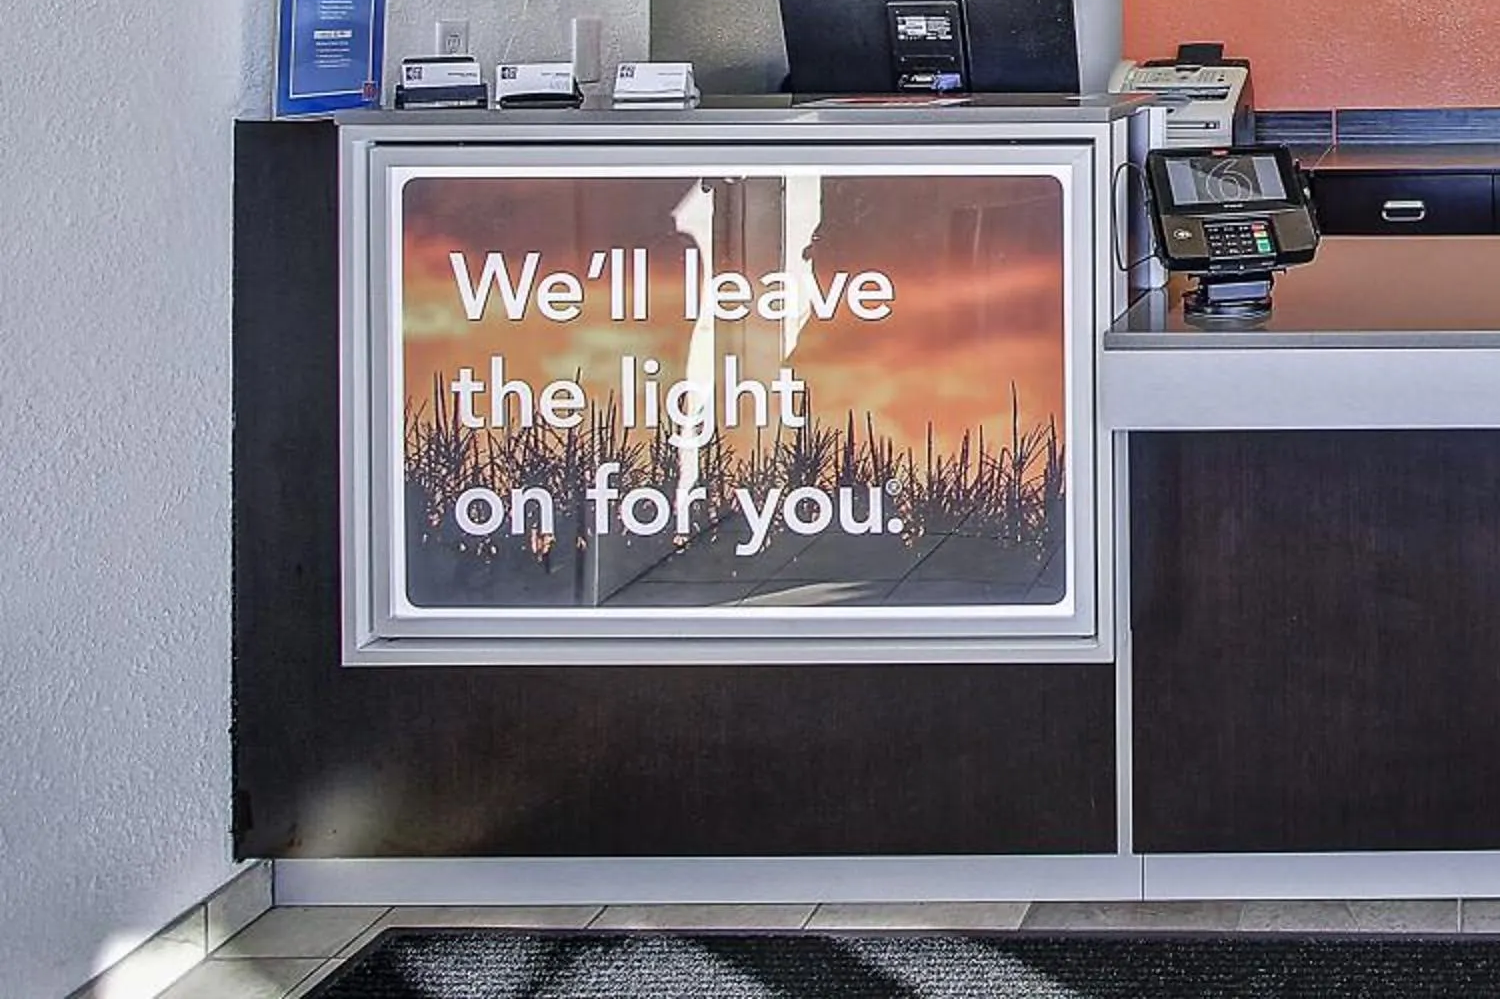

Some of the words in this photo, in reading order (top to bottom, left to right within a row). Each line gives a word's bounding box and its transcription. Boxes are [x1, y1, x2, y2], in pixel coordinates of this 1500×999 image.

[449, 248, 648, 322] We'll
[683, 248, 896, 322] leave
[450, 354, 588, 430] the
[620, 354, 806, 449] light
[454, 485, 555, 536] on
[585, 462, 708, 536] for
